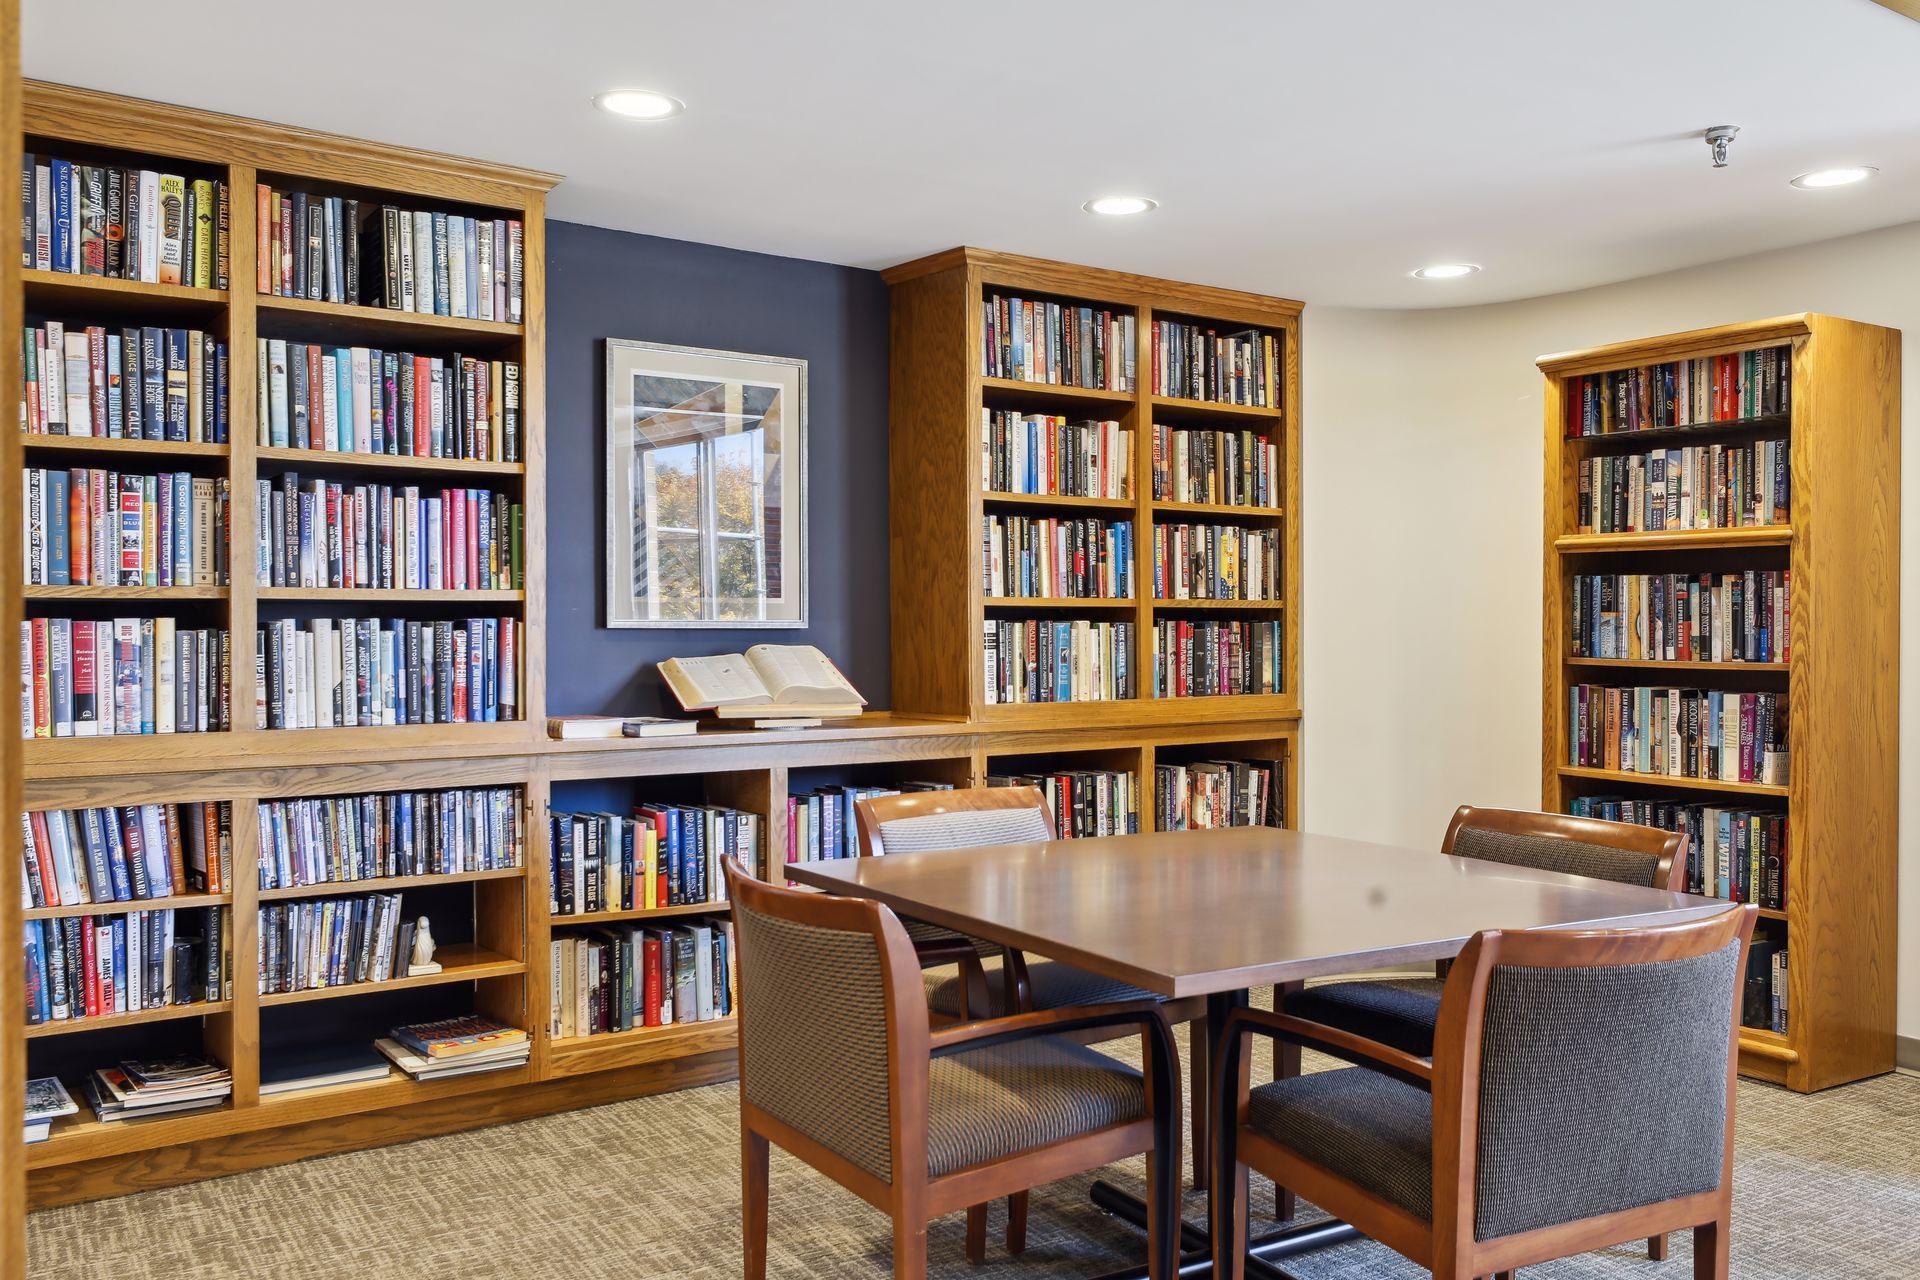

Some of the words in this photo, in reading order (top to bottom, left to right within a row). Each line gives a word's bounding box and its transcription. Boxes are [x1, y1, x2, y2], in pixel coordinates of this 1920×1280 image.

[60, 166, 69, 180] SUE
[109, 171, 120, 188] JULIE
[130, 175, 138, 192] Fast
[60, 181, 69, 216] GRAFTON
[90, 181, 102, 214] GRIFFIN
[161, 187, 183, 195] HALEY'S
[219, 183, 228, 200] JEAN
[109, 190, 120, 223] GARWOOD
[130, 194, 138, 212] Girl
[163, 198, 181, 241] QUEEN
[220, 202, 228, 227] HELLER
[38, 235, 48, 261] VANISH
[108, 241, 119, 265] KILLJOY
[50, 326, 60, 345] Nola
[146, 338, 154, 370] HASSLER
[155, 357, 164, 370] JON
[206, 359, 214, 381] TIPPI
[95, 389, 106, 405] Holy
[128, 376, 137, 409] JUDGMENT
[146, 384, 154, 403] HOPE
[155, 385, 164, 411] NORTH
[206, 383, 214, 422] HEDREN
[96, 407, 104, 424] Fools
[110, 392, 122, 432] JOHANSEN
[129, 410, 139, 432] CALL
[156, 412, 164, 422] OF
[31, 472, 39, 485] the
[109, 475, 117, 486] DR.
[1776, 464, 1784, 481] Silva
[30, 486, 40, 524] nightmare
[109, 488, 117, 509] DEATH
[480, 494, 488, 518] ANNE
[178, 510, 187, 531] Night,
[31, 531, 40, 544] lars
[480, 520, 489, 545] PERRY
[179, 534, 187, 555] Irene
[31, 547, 40, 569] kepler
[54, 626, 60, 635] OF
[457, 632, 466, 661] THOMAS
[1207, 642, 1211, 650] BY
[22, 664, 31, 676] FLY
[345, 651, 353, 675] LAKE
[457, 665, 466, 687] PERRY
[588, 820, 598, 839] HARLAN
[685, 813, 694, 834] BRAD
[130, 832, 140, 848] BOB
[209, 817, 217, 858] AMATEUR
[589, 840, 598, 856] COBEN
[686, 836, 694, 859] THOR
[1719, 843, 1729, 878] WILT
[132, 851, 146, 895] WOODWARD
[589, 873, 598, 885] STAY
[589, 886, 598, 901] CLOSE
[102, 958, 112, 979] JAMES
[104, 984, 113, 1000] HALL
